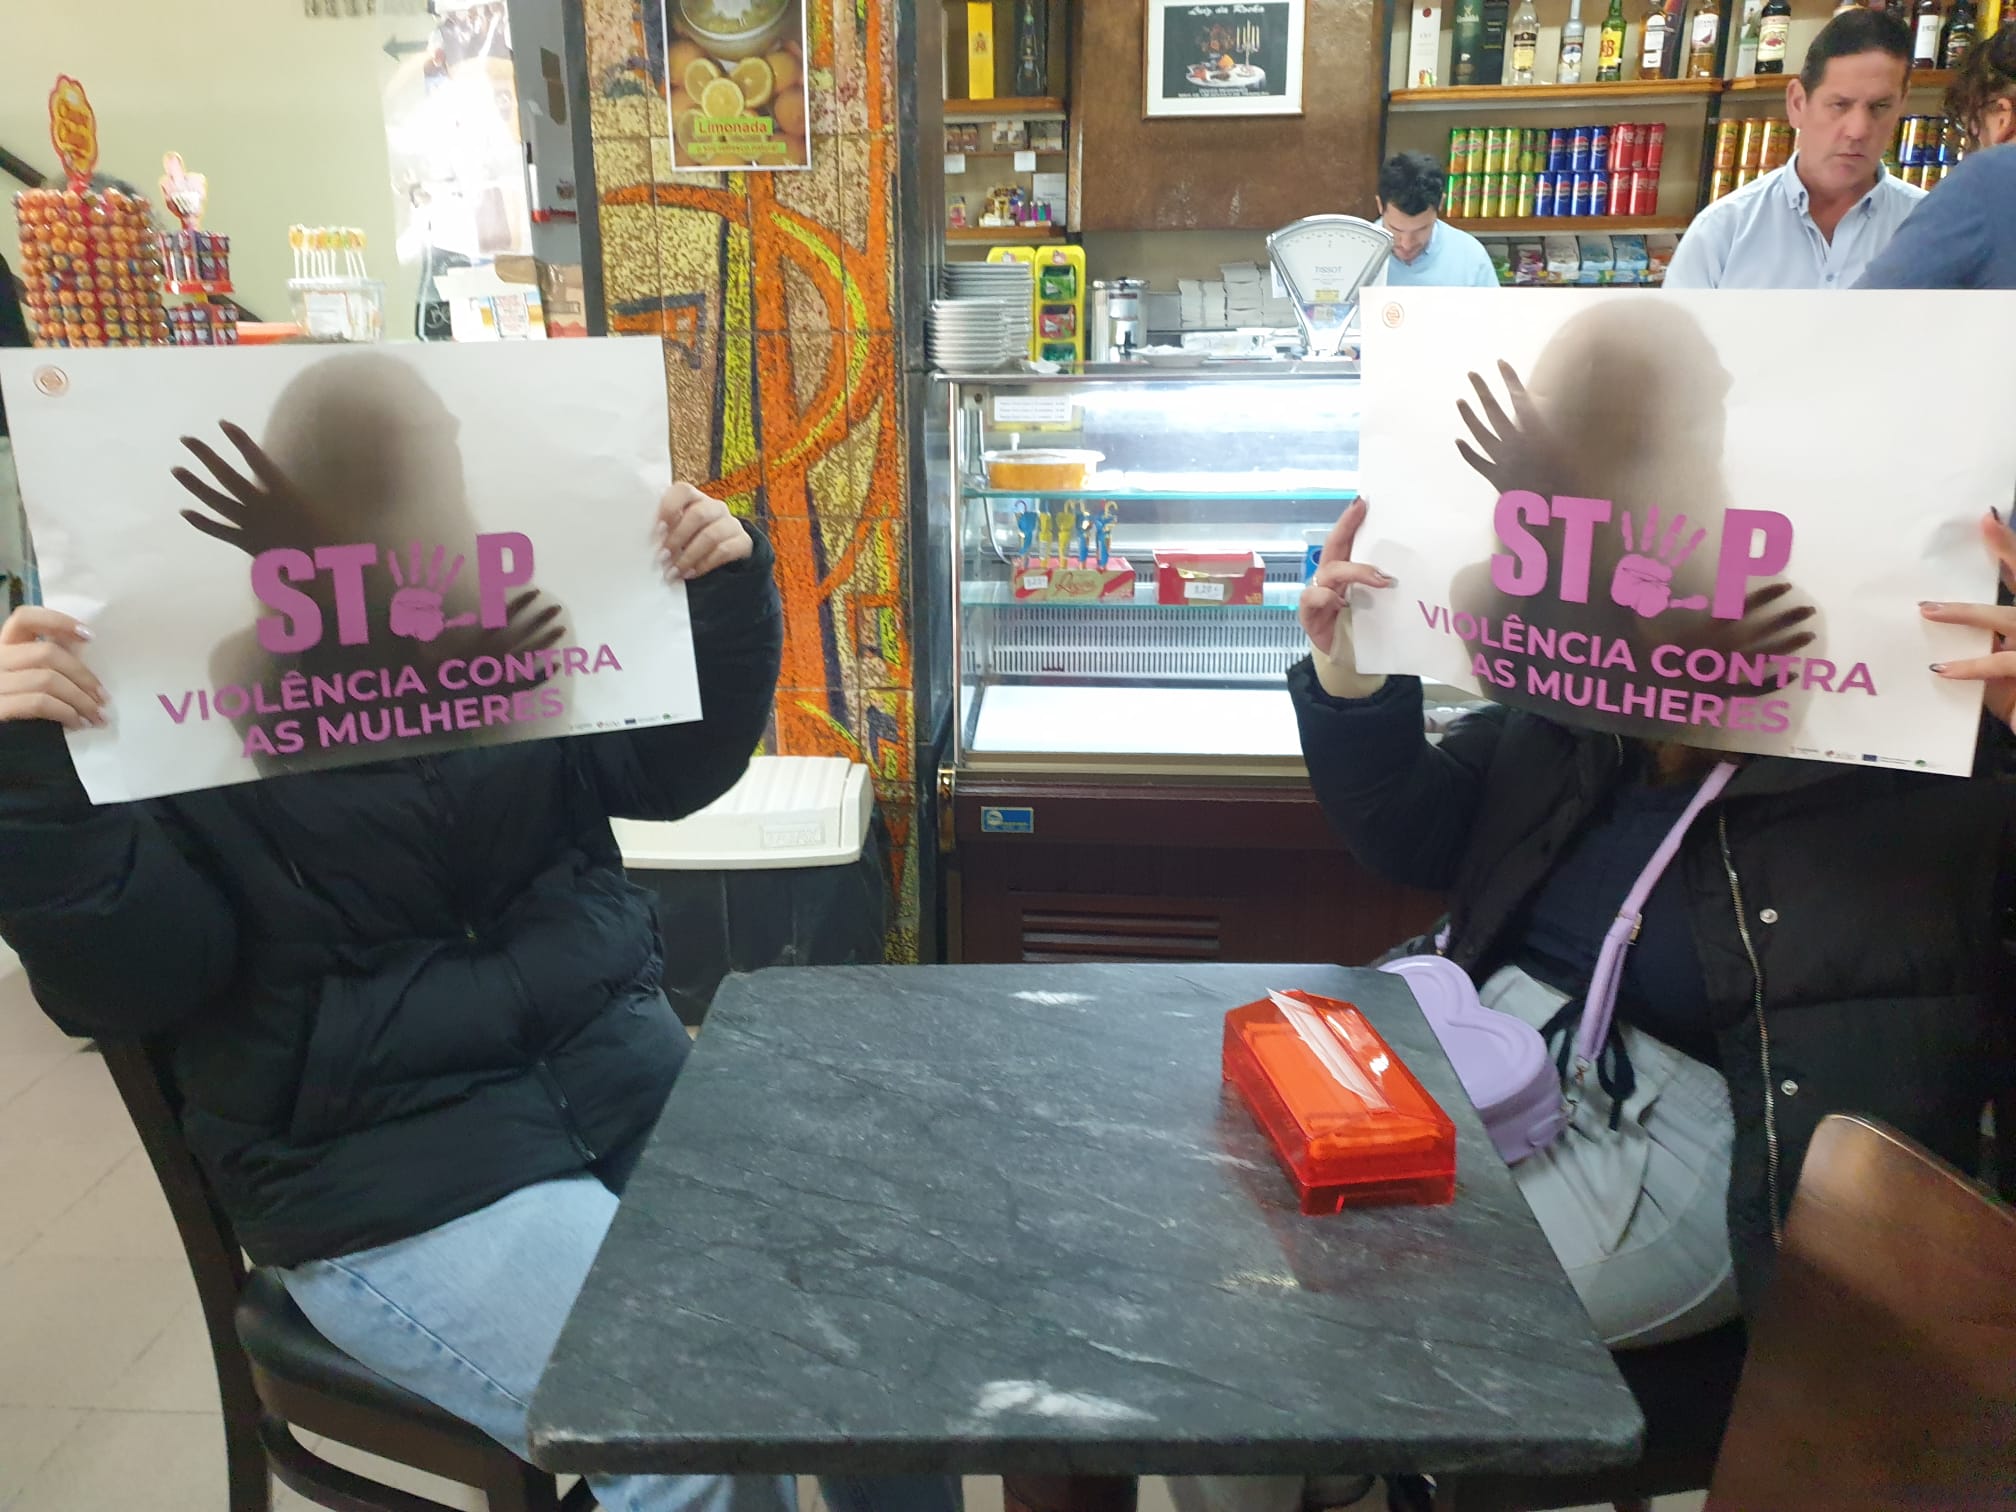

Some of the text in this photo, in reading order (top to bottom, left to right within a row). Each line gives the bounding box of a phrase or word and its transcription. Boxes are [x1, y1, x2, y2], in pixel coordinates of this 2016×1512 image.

[699, 121, 768, 134] Limonada
[157, 643, 623, 725] VIOLÊNCIA CONTRA
[1417, 599, 1878, 696] VIOLÊNCIA CONTRA
[242, 687, 565, 758] AS MULHERES
[1471, 652, 1791, 734] AS MULHERES
